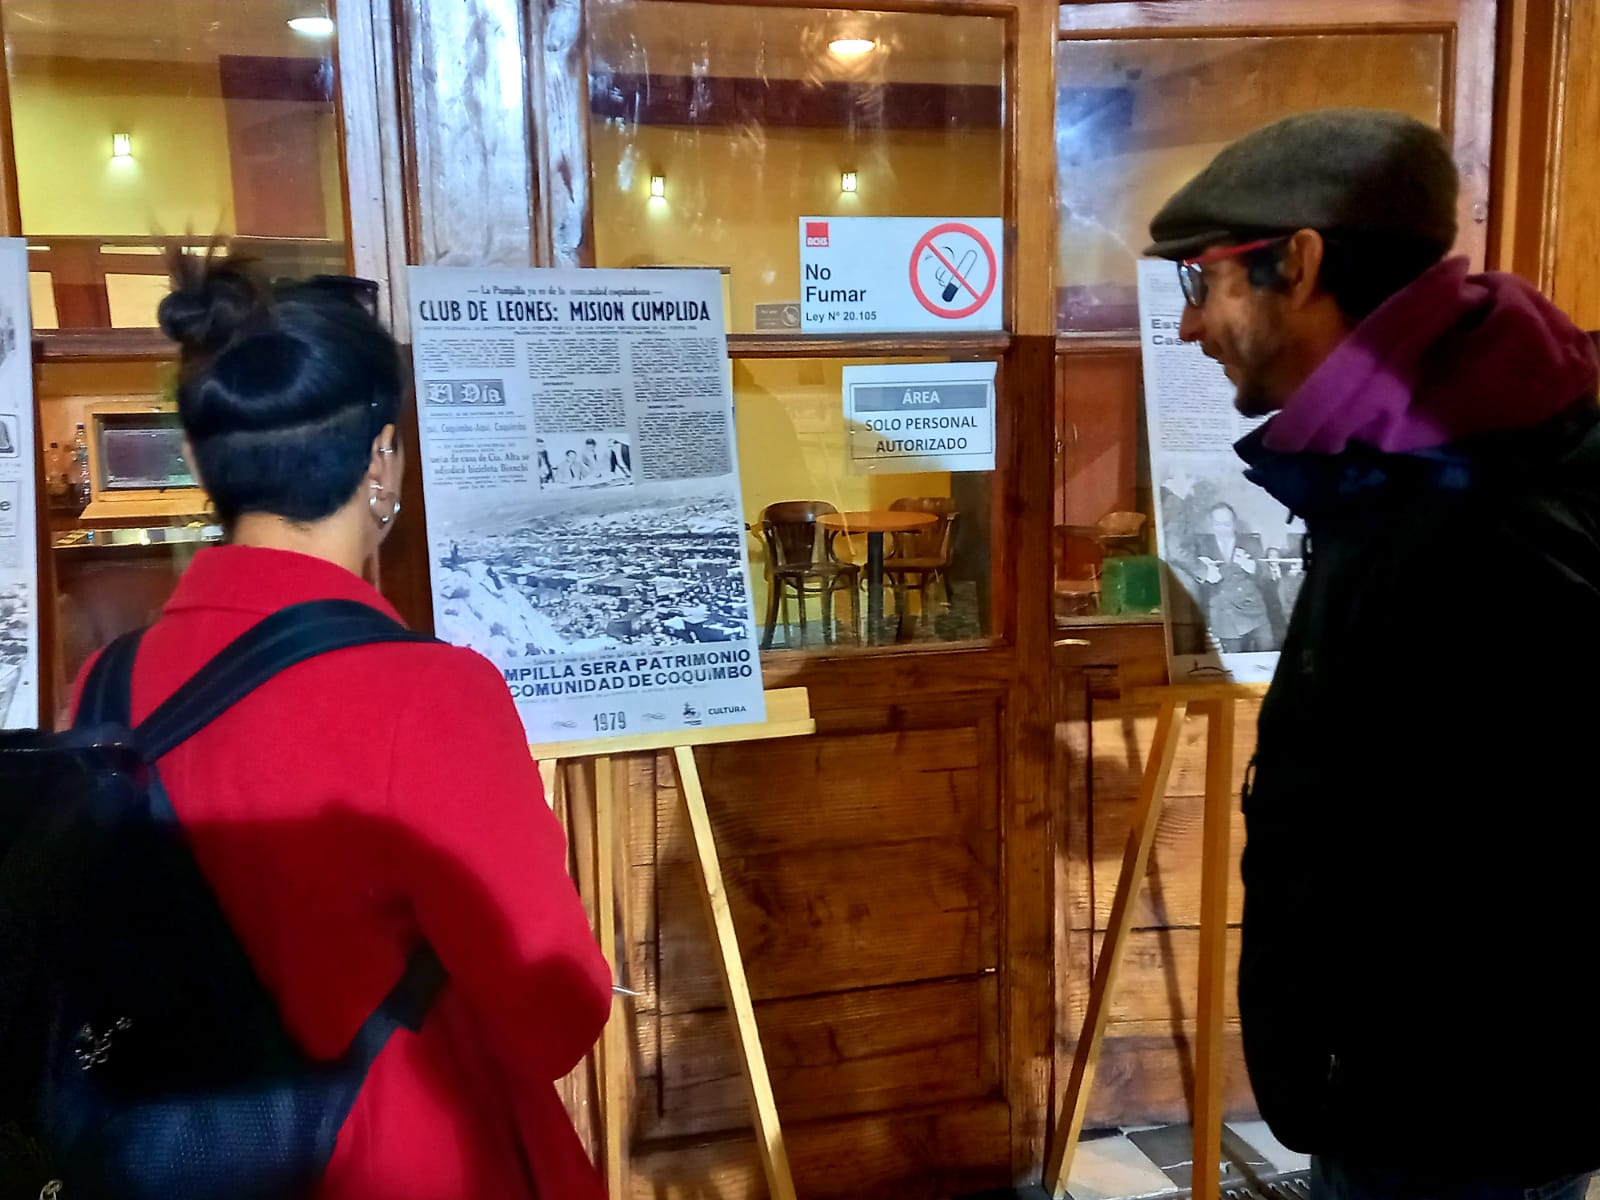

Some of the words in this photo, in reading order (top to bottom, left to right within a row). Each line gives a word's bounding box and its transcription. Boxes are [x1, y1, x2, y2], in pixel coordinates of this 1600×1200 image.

[805, 263, 832, 281] No
[805, 285, 867, 303] Fumar
[419, 300, 462, 321] CLUB
[467, 300, 489, 321] DE
[497, 300, 559, 321] LEONES:
[569, 300, 625, 321] MISION
[631, 300, 711, 321] CUMPLIDA
[806, 311, 825, 323] Ley
[843, 311, 877, 321] 20.105
[427, 383, 454, 404] El
[902, 388, 941, 405] ÁREA
[865, 418, 902, 432] SOLO
[905, 415, 978, 430] PERSONAL
[876, 437, 968, 453] AUTORIZADO
[504, 665, 576, 681] MPILLA
[581, 660, 632, 677] SERA
[636, 649, 751, 672] PATRIMONIO
[509, 676, 624, 698] COMUNIDAD
[628, 673, 653, 688] DE
[655, 664, 753, 685] COQUIMBO
[708, 705, 747, 715] CULTURA
[593, 711, 627, 732] 1979
